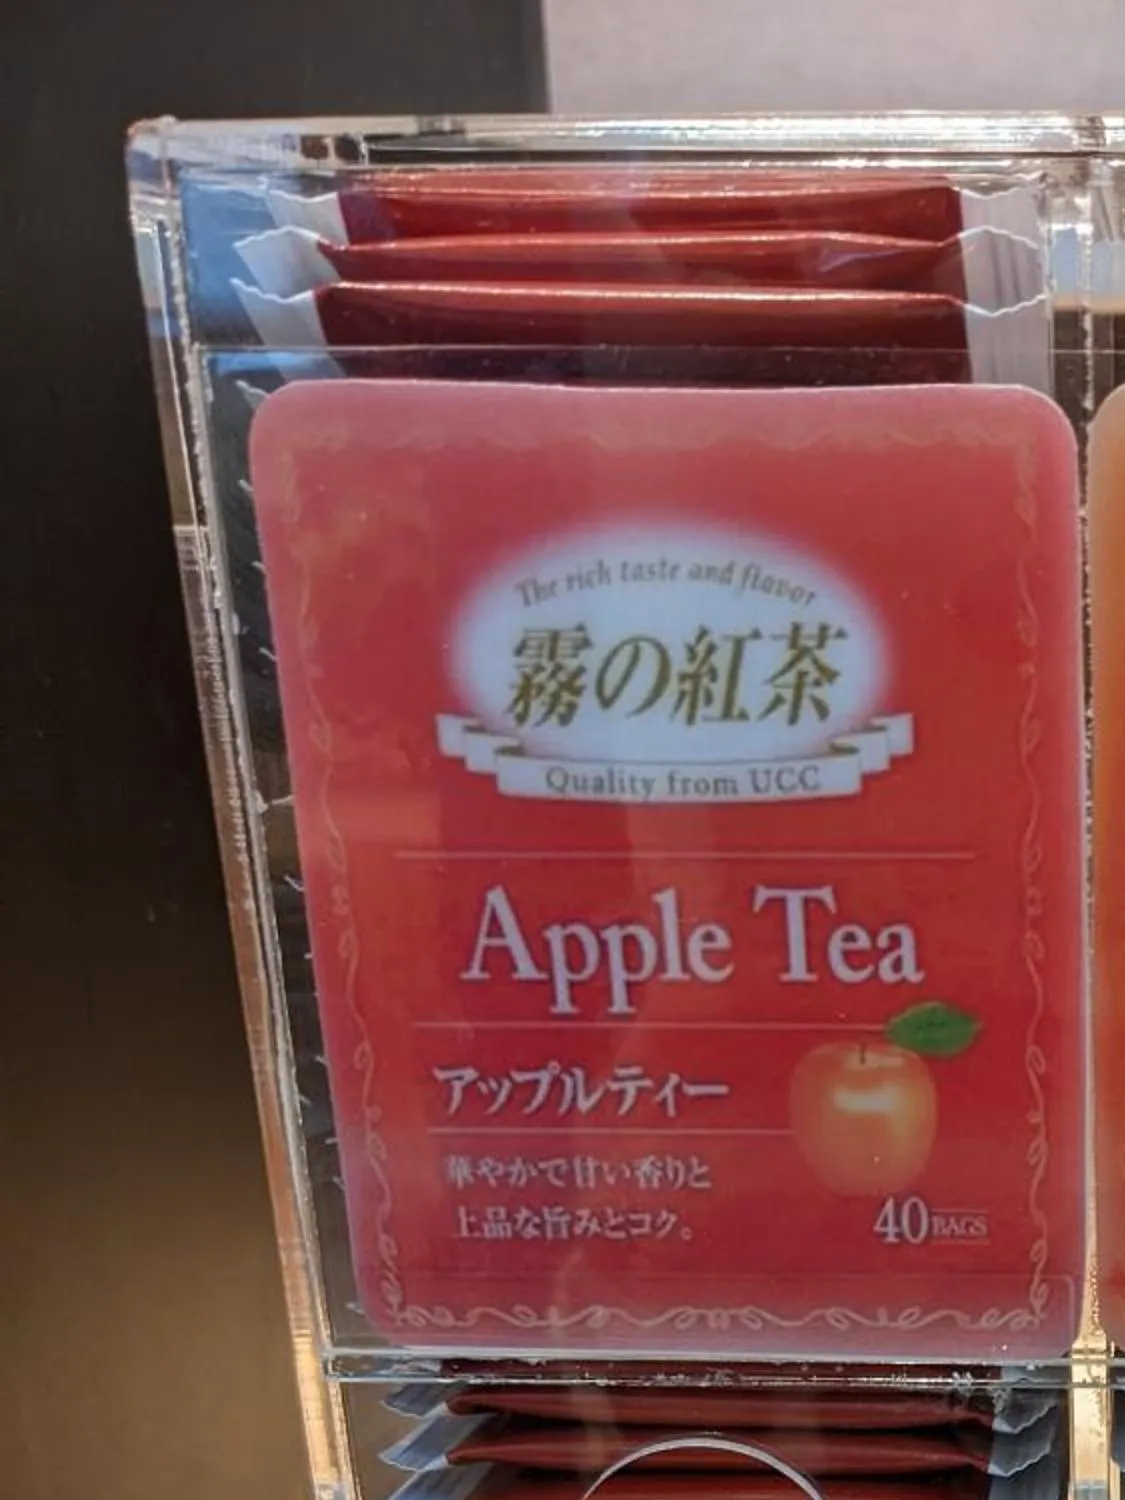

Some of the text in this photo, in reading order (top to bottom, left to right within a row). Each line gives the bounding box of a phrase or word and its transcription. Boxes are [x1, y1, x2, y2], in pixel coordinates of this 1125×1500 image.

[515, 558, 817, 608] The rich taste and flavor
[507, 622, 850, 728] 霧の紅茶
[546, 766, 822, 801] Quality from UCC
[460, 884, 925, 1015] Apple Tea
[432, 1061, 730, 1118] アップルティー
[446, 1155, 712, 1190] 華やかで甘い香りと
[873, 1196, 989, 1246] 40 BAGS
